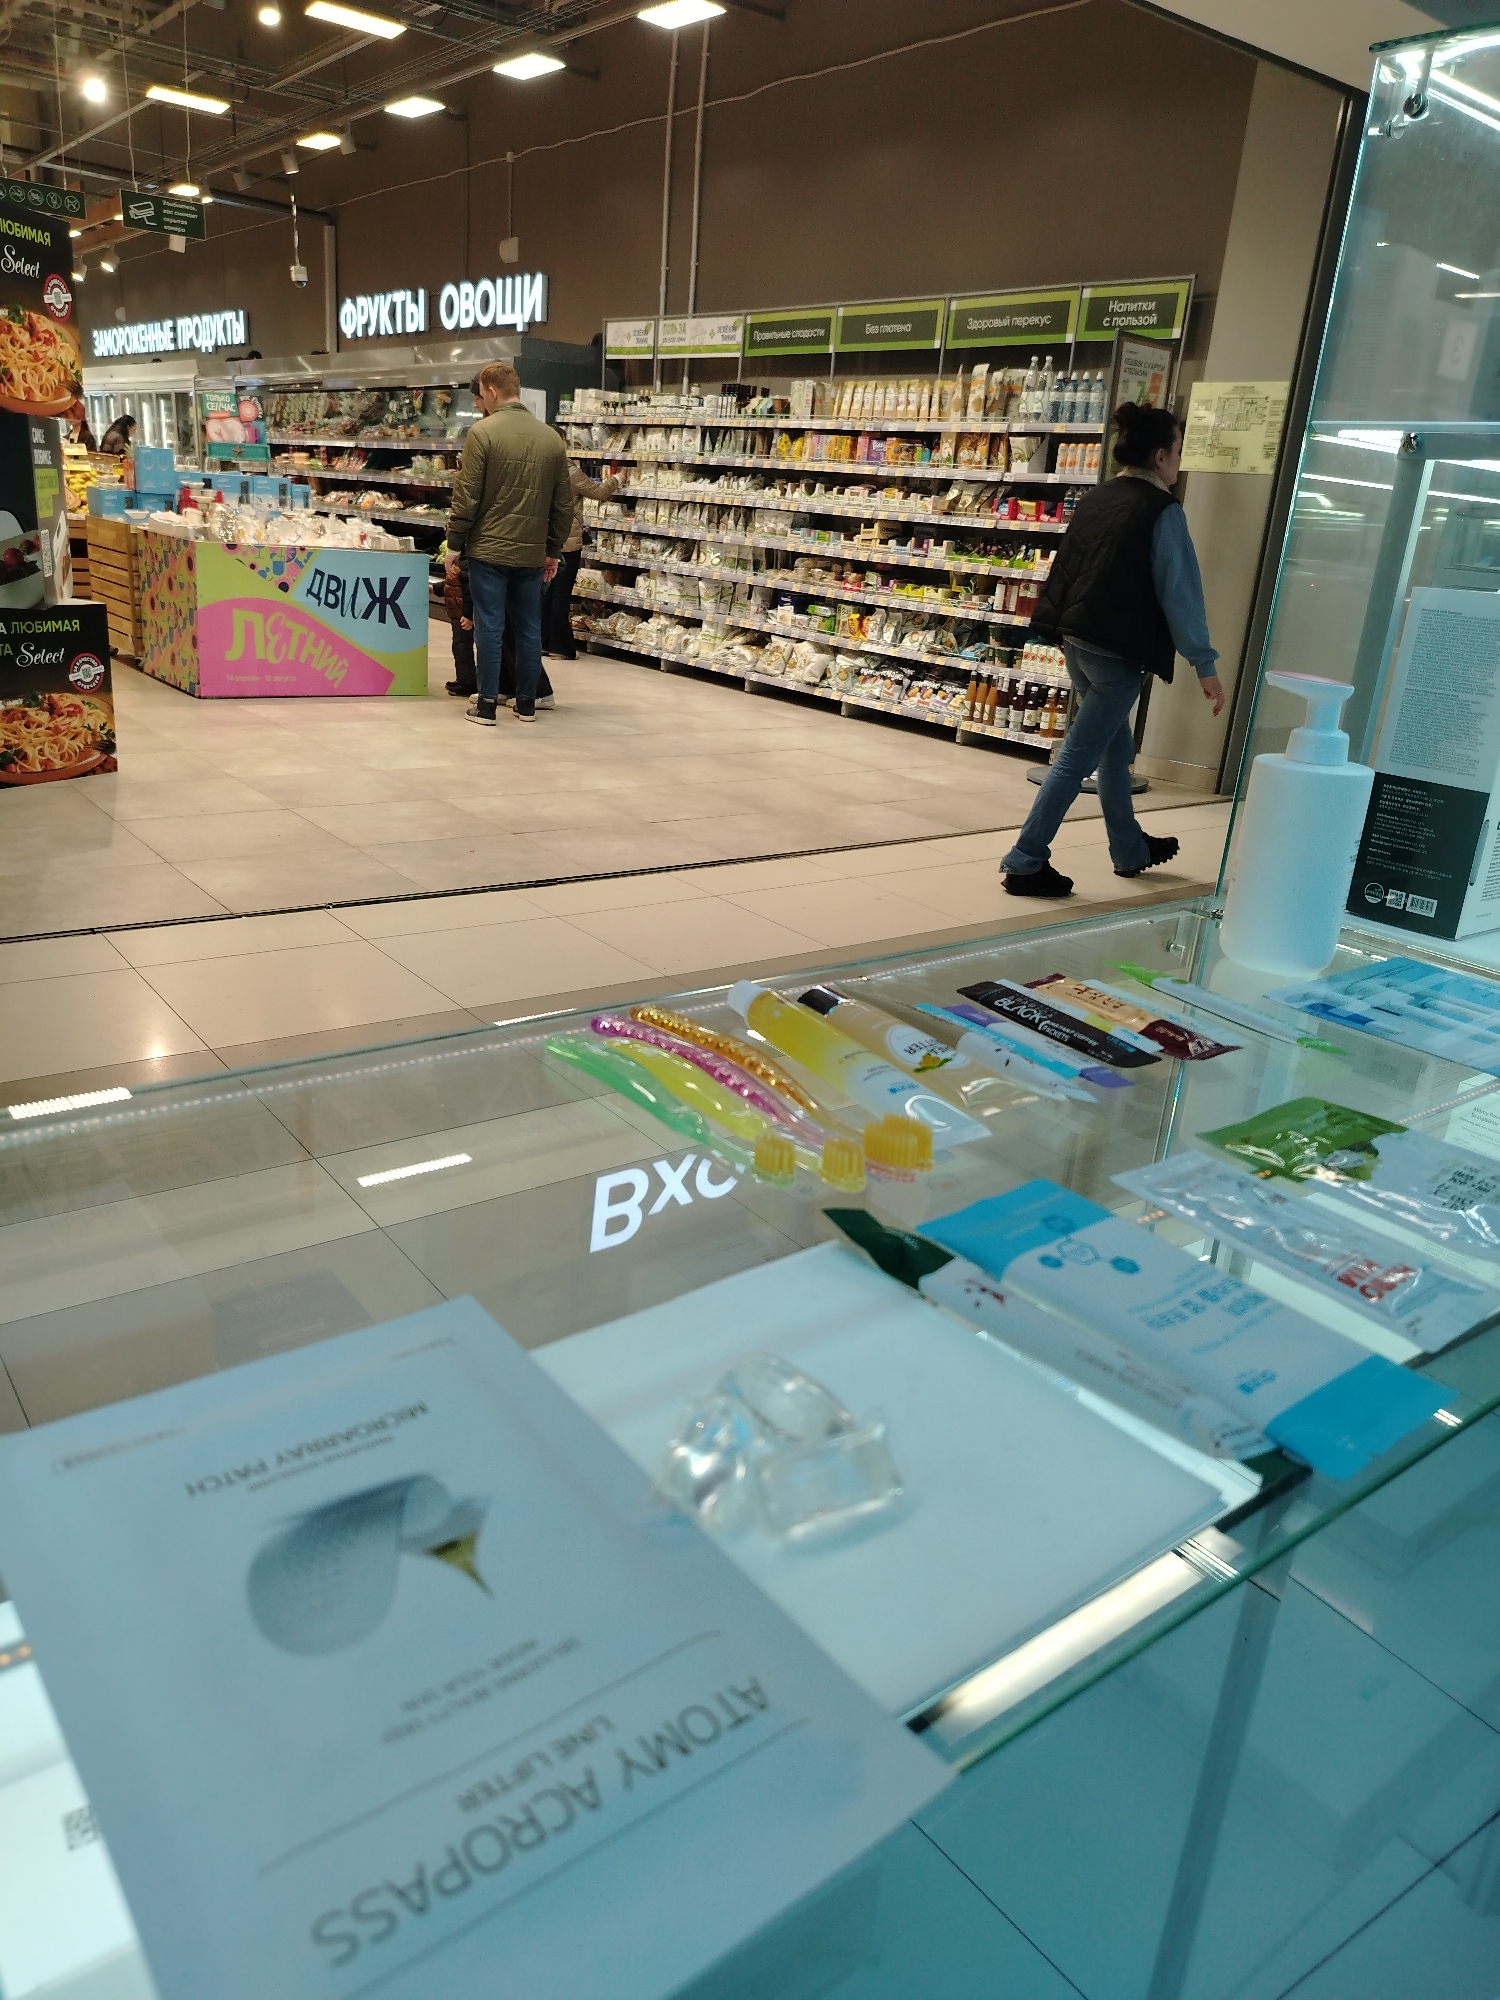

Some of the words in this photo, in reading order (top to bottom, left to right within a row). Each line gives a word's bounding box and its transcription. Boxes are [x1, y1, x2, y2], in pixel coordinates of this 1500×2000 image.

[1, 244, 39, 278] Select
[339, 286, 425, 338] ФРУКТЫ
[439, 271, 545, 332] ОВОЩИ
[966, 314, 1010, 330] Здоровый
[1011, 313, 1052, 328] перекус
[1103, 317, 1110, 326] с
[1111, 313, 1157, 327] пользой
[1108, 300, 1156, 313] Напитки
[93, 320, 175, 357] ЗАМОРОЖЕННЫЕ
[176, 308, 245, 353] ПРОДУКТЫ
[753, 330, 791, 342] Правильные
[791, 327, 825, 340] сладости
[865, 323, 879, 335] Без
[879, 322, 912, 334] глютена
[205, 394, 231, 403] ТОЛЬКО
[306, 568, 412, 630] ДВИЖ
[11, 619, 80, 634] ЛЮБИМАЯ
[16, 642, 66, 668] Select
[225, 608, 349, 688] ЛЕТНИЙ
[994, 996, 1042, 1024] BLACK
[590, 1153, 739, 1254] Вхо
[272, 1400, 431, 1467] MICROARRAY
[184, 1457, 269, 1499] PATCH
[540, 1714, 618, 1771] LINE
[621, 1675, 773, 1797] ATOMY
[452, 1750, 538, 1812] LIFTER
[308, 1780, 606, 1969] ACROPASS
